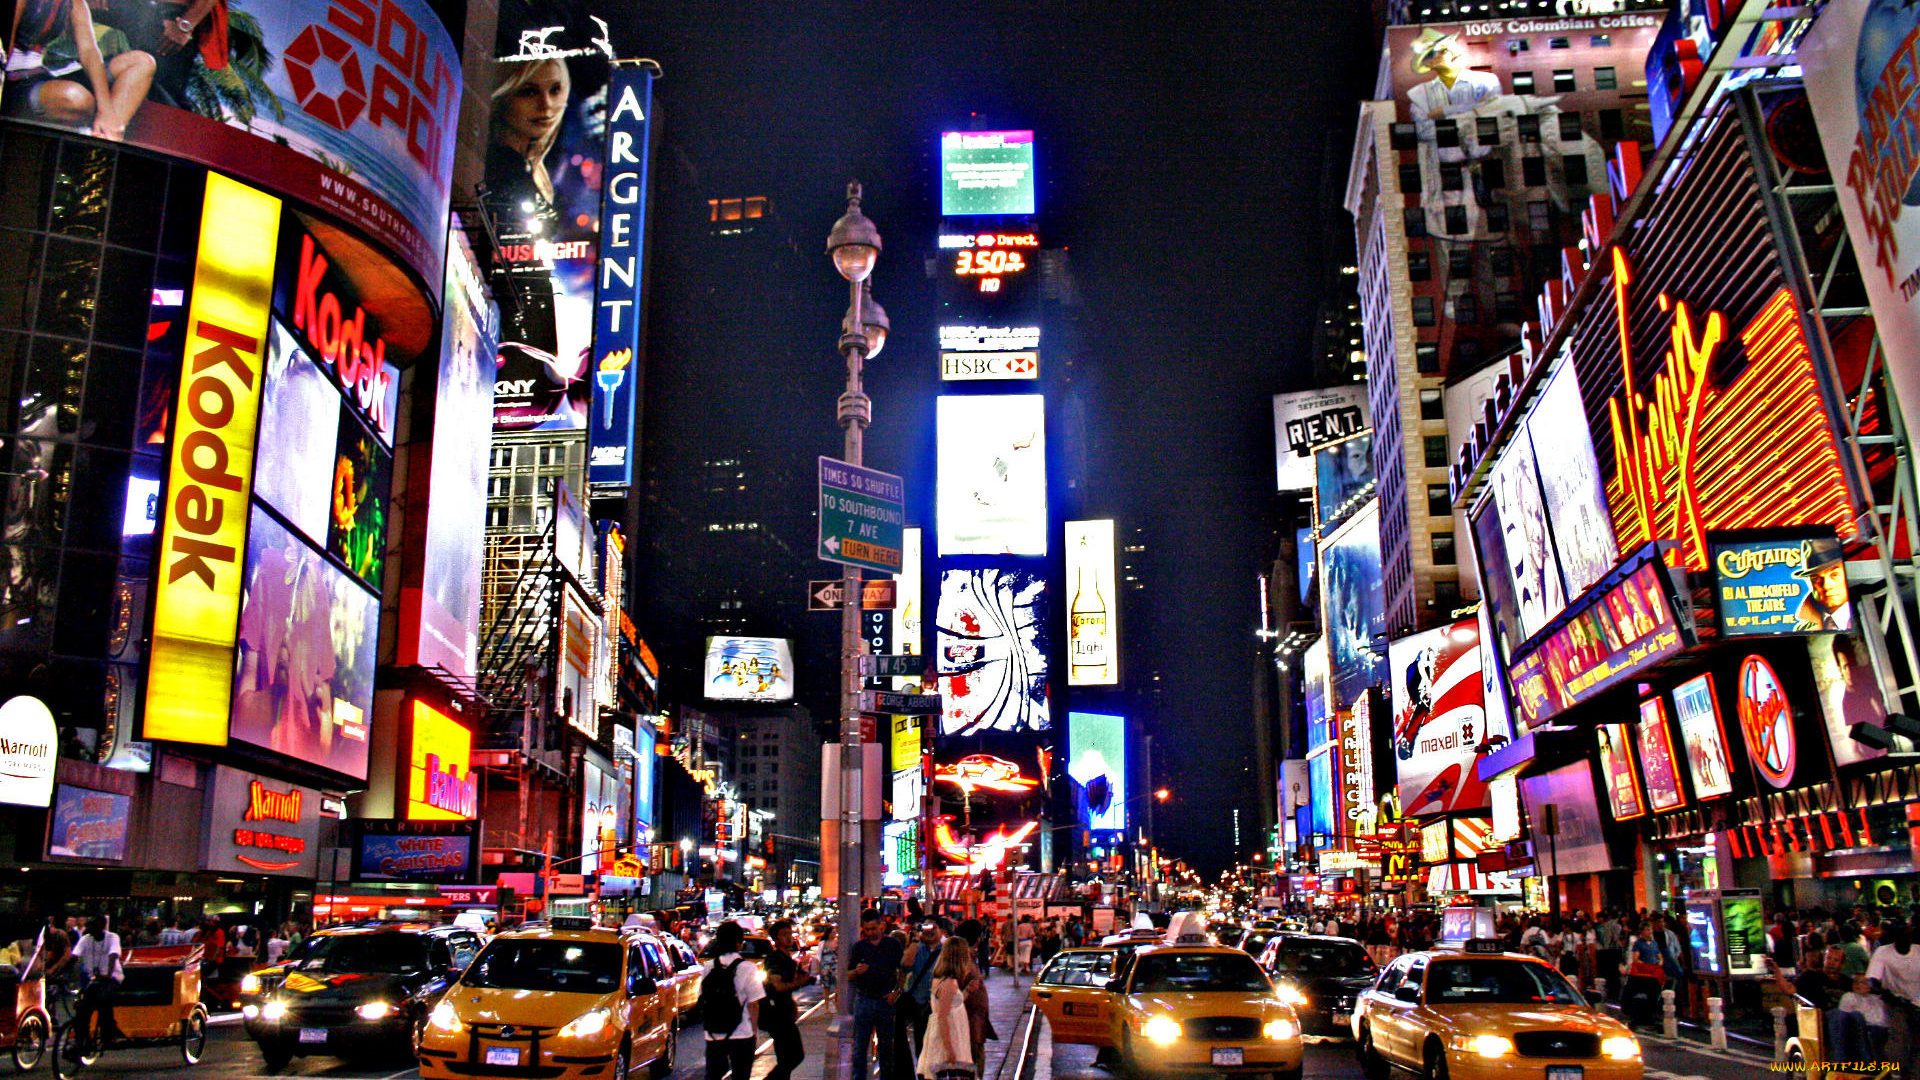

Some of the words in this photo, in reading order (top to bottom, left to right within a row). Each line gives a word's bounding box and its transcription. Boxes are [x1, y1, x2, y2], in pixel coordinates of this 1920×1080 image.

[1465, 22, 1503, 36] 100%
[1507, 18, 1595, 33] Colombian
[1598, 14, 1655, 28] Coffee
[601, 85, 645, 333] ARGENT
[533, 238, 590, 261] NGHT
[1449, 141, 1630, 499] BERTELSMANN
[294, 234, 391, 433] Kodak
[944, 358, 1000, 374] HSBC
[1289, 411, 1356, 445] RENT
[168, 320, 258, 592] Kodak
[823, 467, 848, 485] TIMES
[865, 478, 899, 499] SHUFFLE
[823, 494, 836, 509] TO
[839, 498, 904, 525] SOUTHBOUND
[848, 520, 854, 533] 7
[859, 523, 879, 539] AVE
[843, 540, 870, 560] TURN
[873, 548, 899, 566] HERE
[1735, 585, 1749, 600] AL
[1748, 583, 1801, 598] HIRSCHFELD
[1745, 598, 1786, 612] THEATRE
[880, 658, 888, 673] W
[893, 658, 907, 673] 45
[877, 694, 905, 707] GEORGE
[907, 697, 940, 708] ABBOTT
[1421, 731, 1459, 754] maxell
[1344, 720, 1359, 820] PALACE
[245, 780, 302, 823] Marriott
[364, 821, 473, 833] MARQUIS
[396, 837, 445, 853] WHITE
[381, 851, 463, 875] CHRISTMAS
[441, 892, 471, 900] TERS
